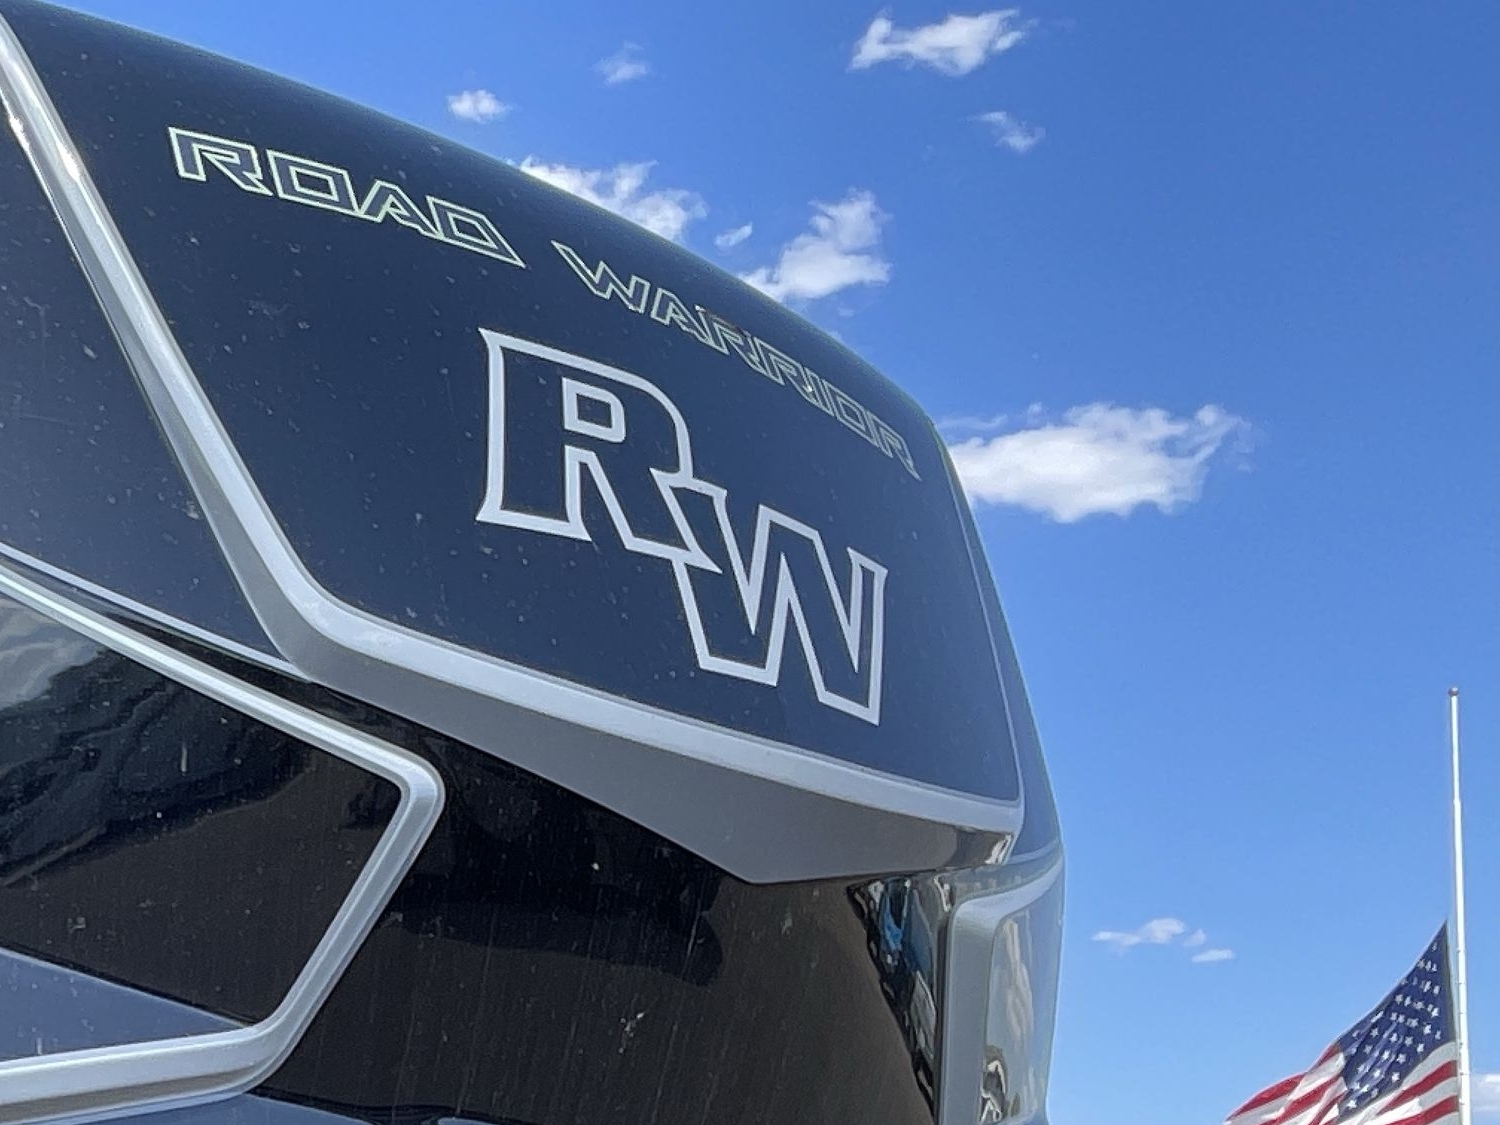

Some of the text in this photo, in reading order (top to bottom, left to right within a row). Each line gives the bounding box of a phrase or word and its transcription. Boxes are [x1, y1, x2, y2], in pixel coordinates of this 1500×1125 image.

[168, 126, 923, 482] ROAD WARRIOR
[476, 327, 888, 726] RW
